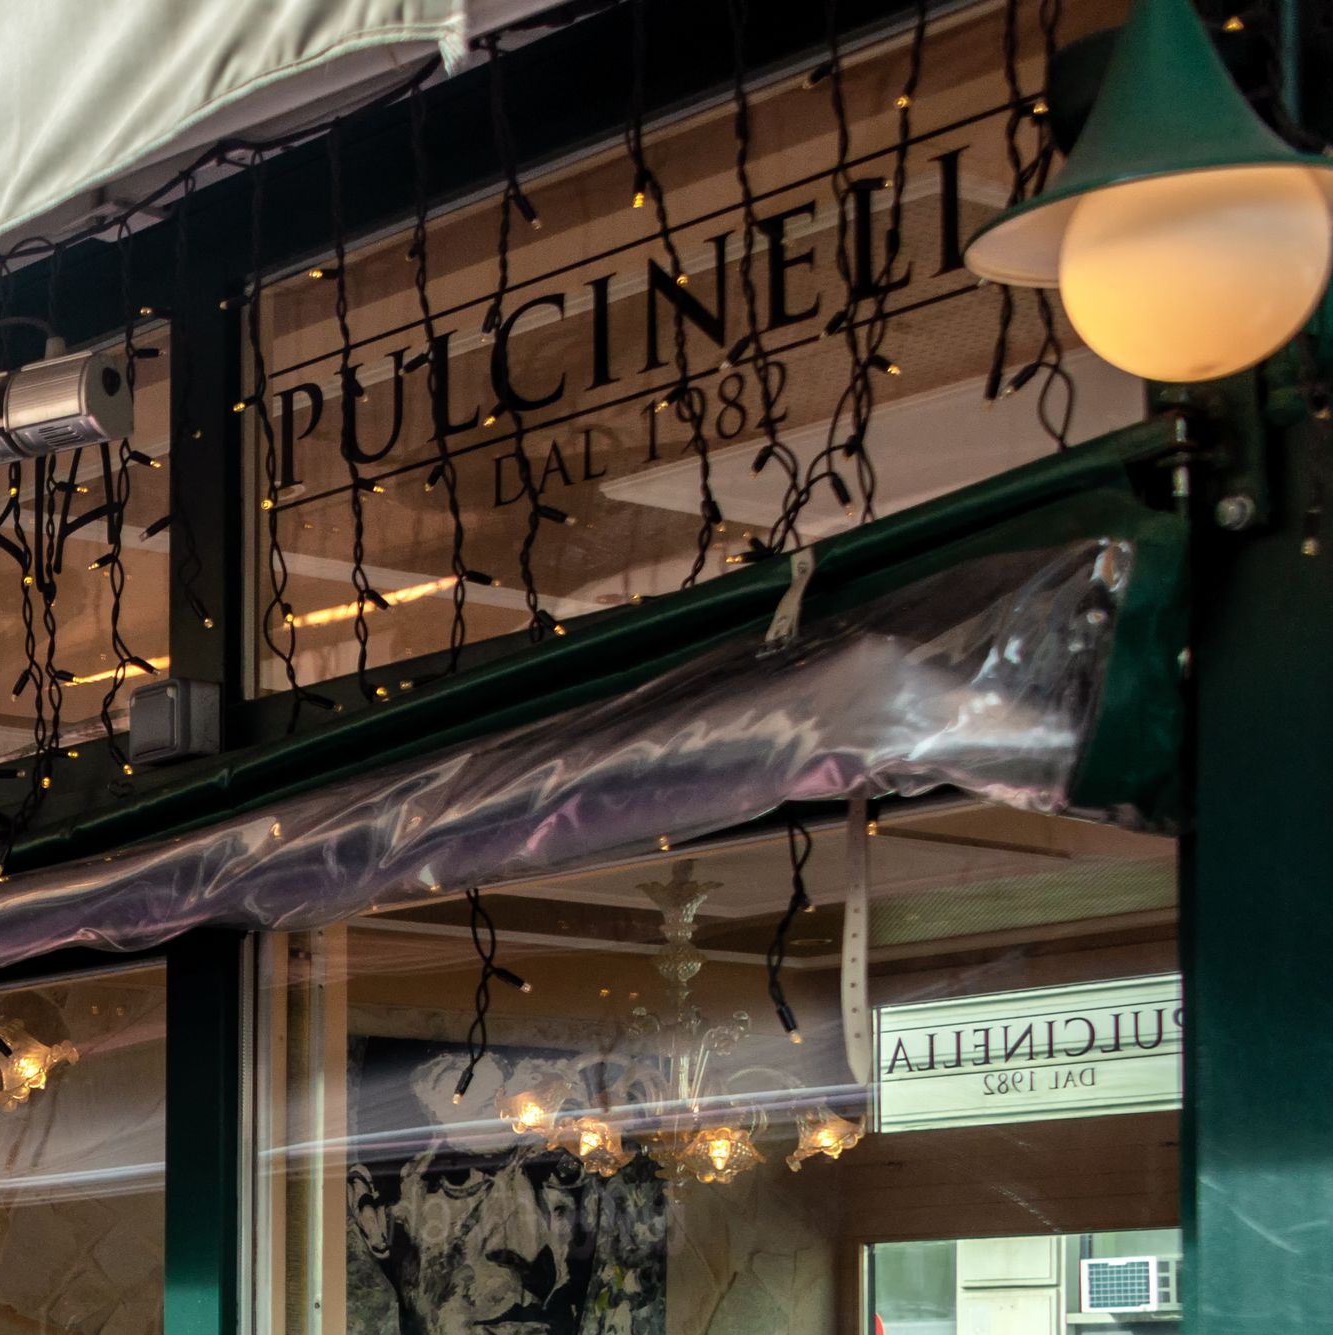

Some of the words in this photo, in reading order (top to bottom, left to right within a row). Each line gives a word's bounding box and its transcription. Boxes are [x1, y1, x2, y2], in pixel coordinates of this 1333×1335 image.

[276, 146, 975, 489] PULCINELL
[493, 428, 608, 508] DAL
[643, 360, 789, 463] 1982
